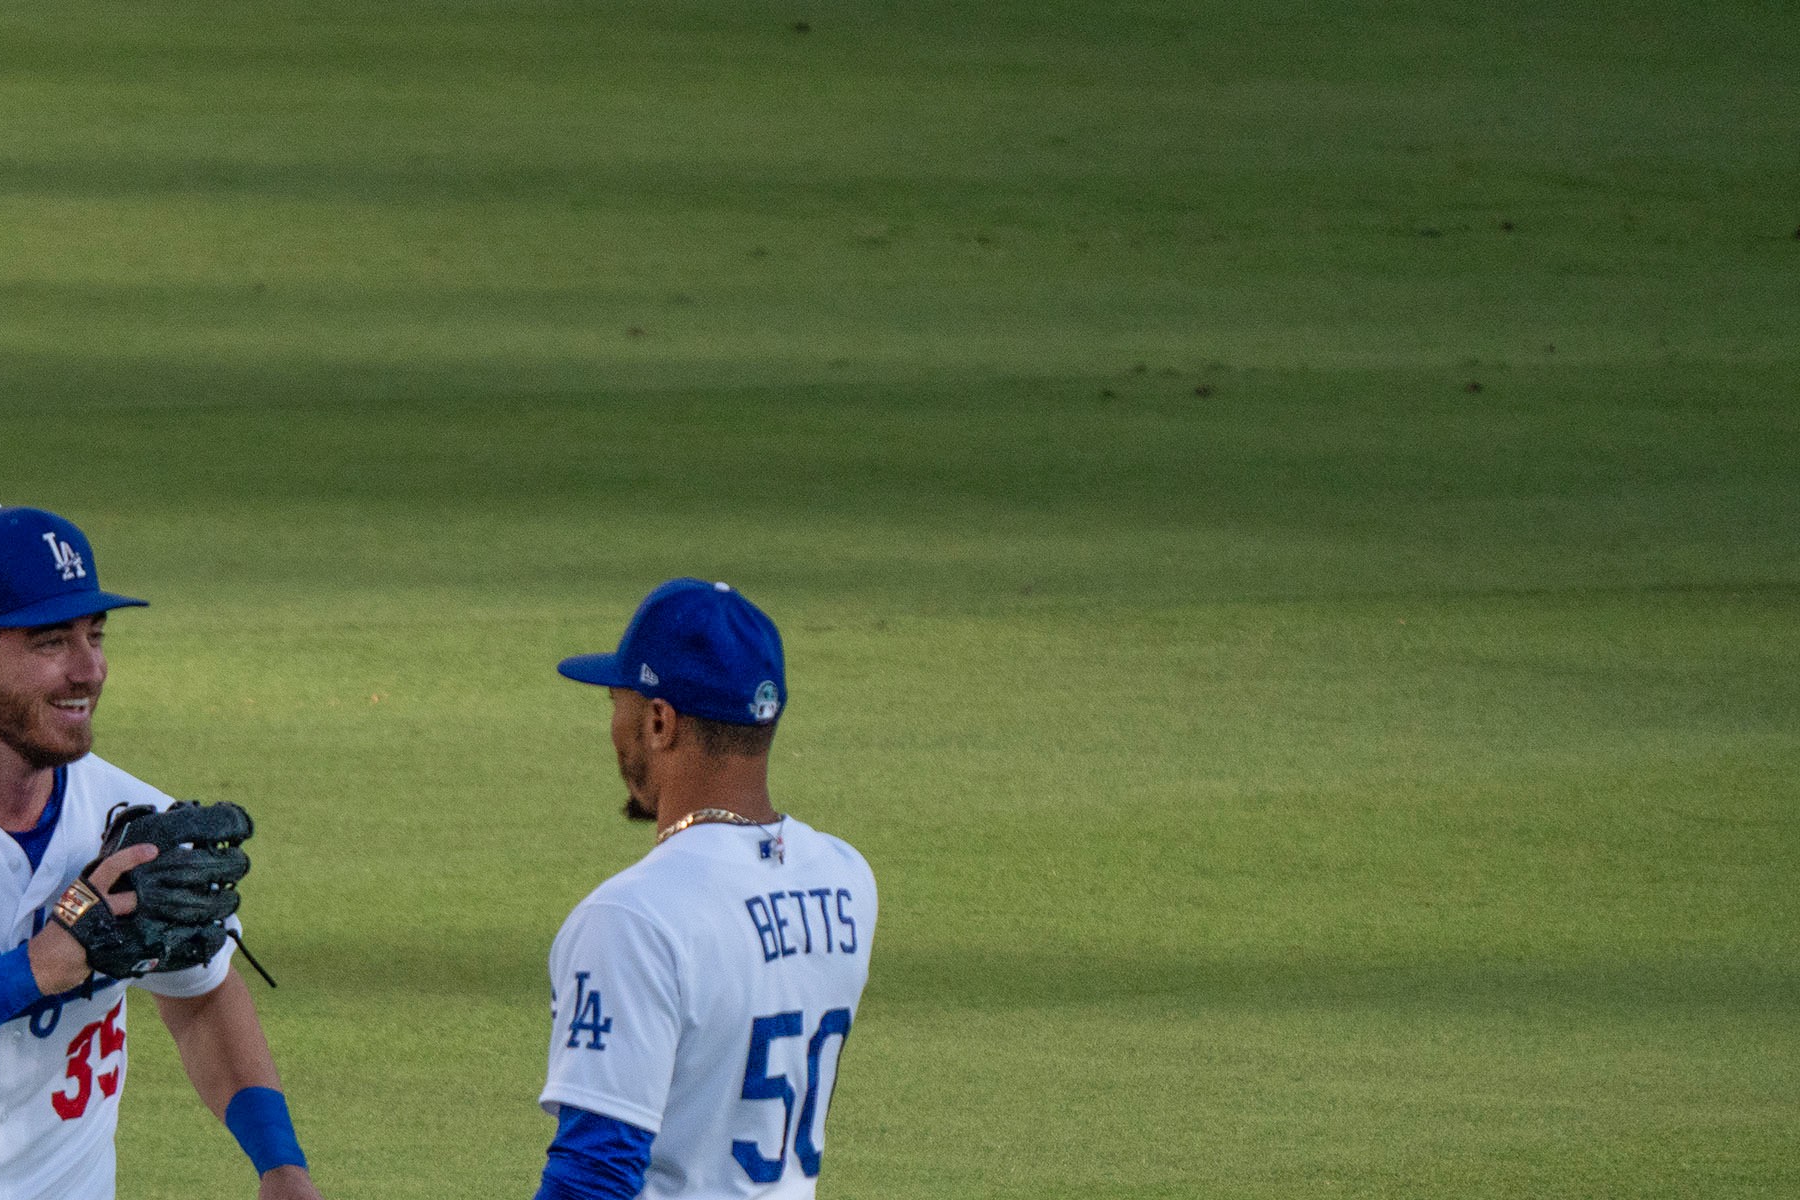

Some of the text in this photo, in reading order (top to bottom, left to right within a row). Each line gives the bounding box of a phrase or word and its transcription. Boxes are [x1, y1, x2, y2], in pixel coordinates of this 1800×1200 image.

[42, 532, 86, 581] LA
[745, 888, 858, 962] BETTS
[566, 971, 613, 1051] LA
[51, 999, 126, 1121] 35
[731, 1007, 852, 1184] 50
